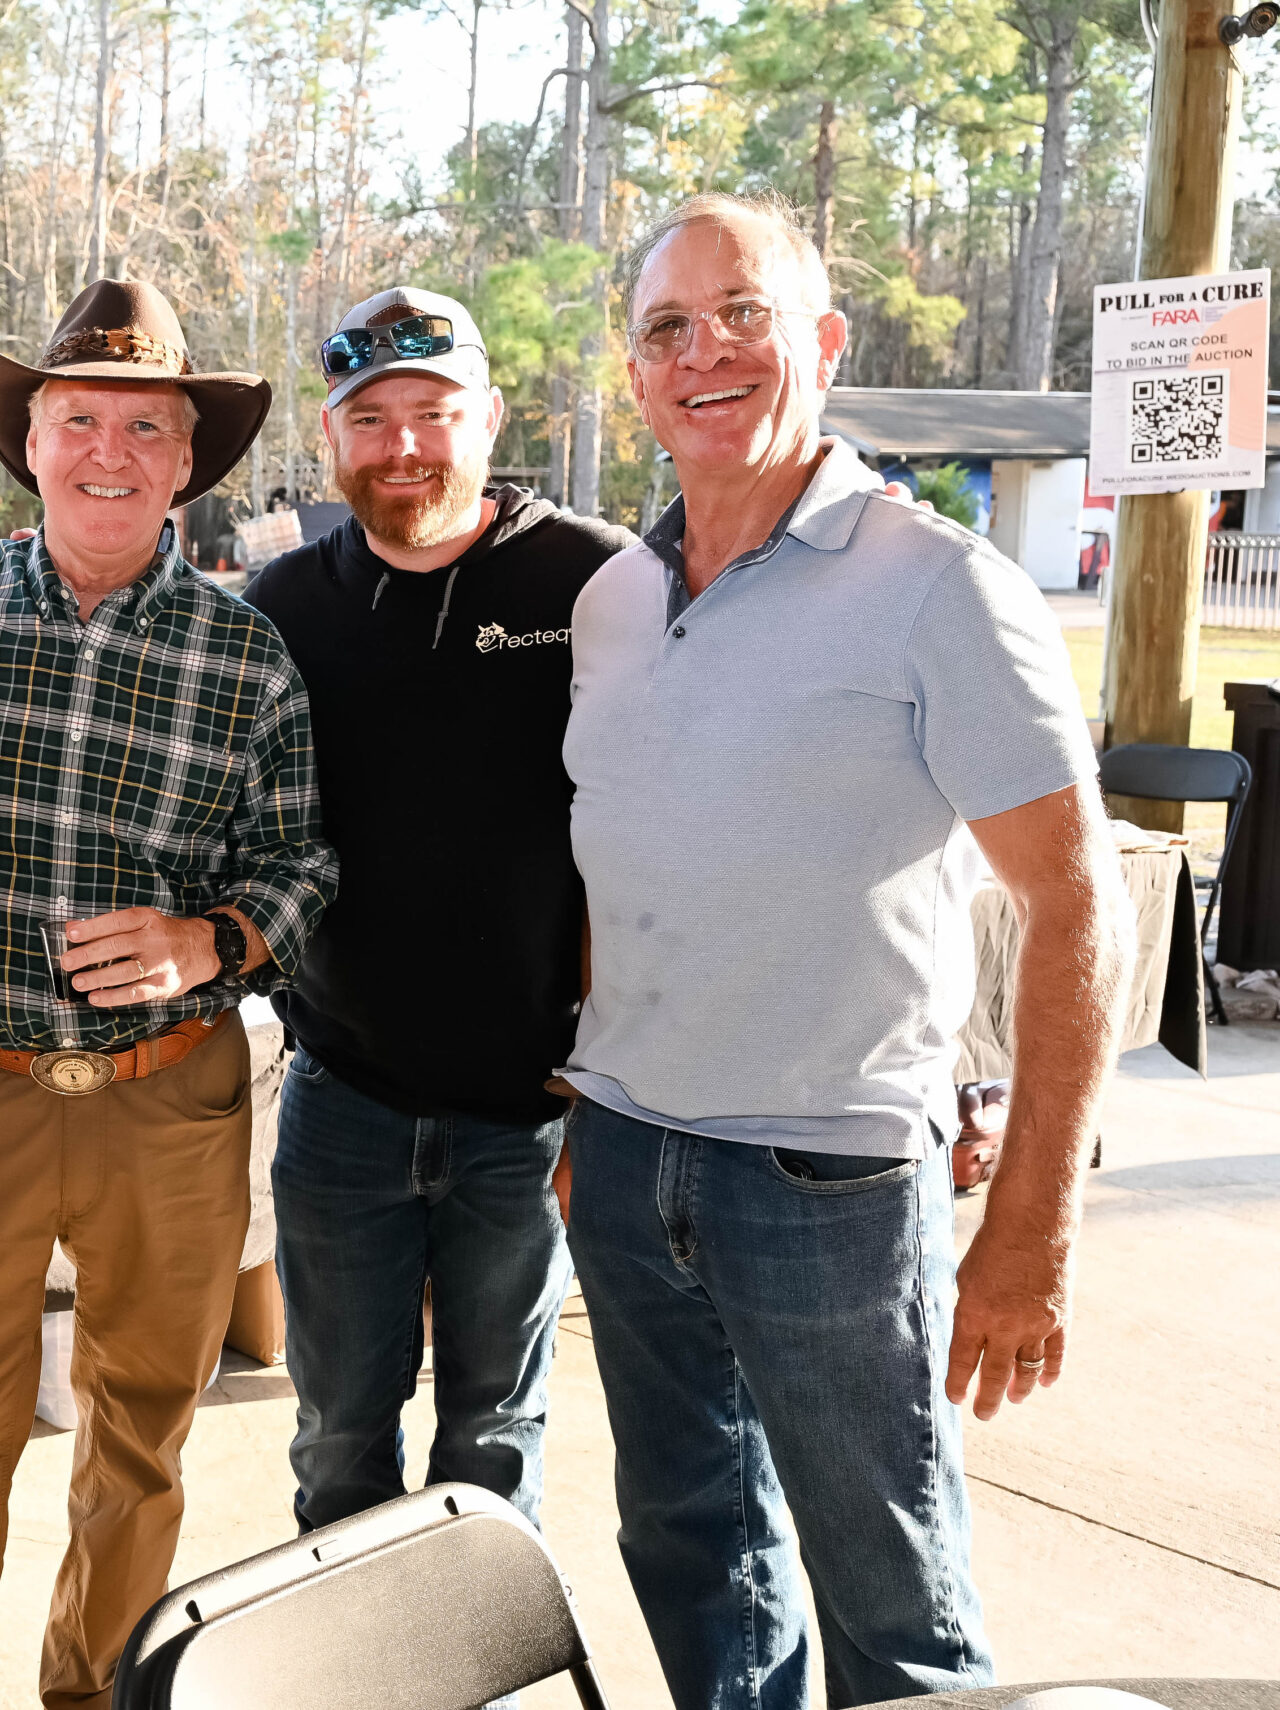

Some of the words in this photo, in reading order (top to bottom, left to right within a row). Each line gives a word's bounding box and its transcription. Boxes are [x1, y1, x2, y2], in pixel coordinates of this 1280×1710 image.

[1100, 293, 1155, 313] PULL
[1159, 294, 1184, 304] FOR
[1189, 292, 1198, 302] A
[1202, 282, 1264, 303] CURE
[1152, 308, 1200, 327] FARA
[1131, 339, 1165, 351] SCAN
[1169, 337, 1188, 348] QR
[1192, 334, 1228, 346] CODE
[1106, 359, 1122, 370] TO
[1126, 356, 1147, 368] BID
[1150, 354, 1162, 365] IN
[1167, 353, 1190, 364] THE
[1195, 349, 1253, 362] AUCTION
[499, 628, 569, 650] recteq
